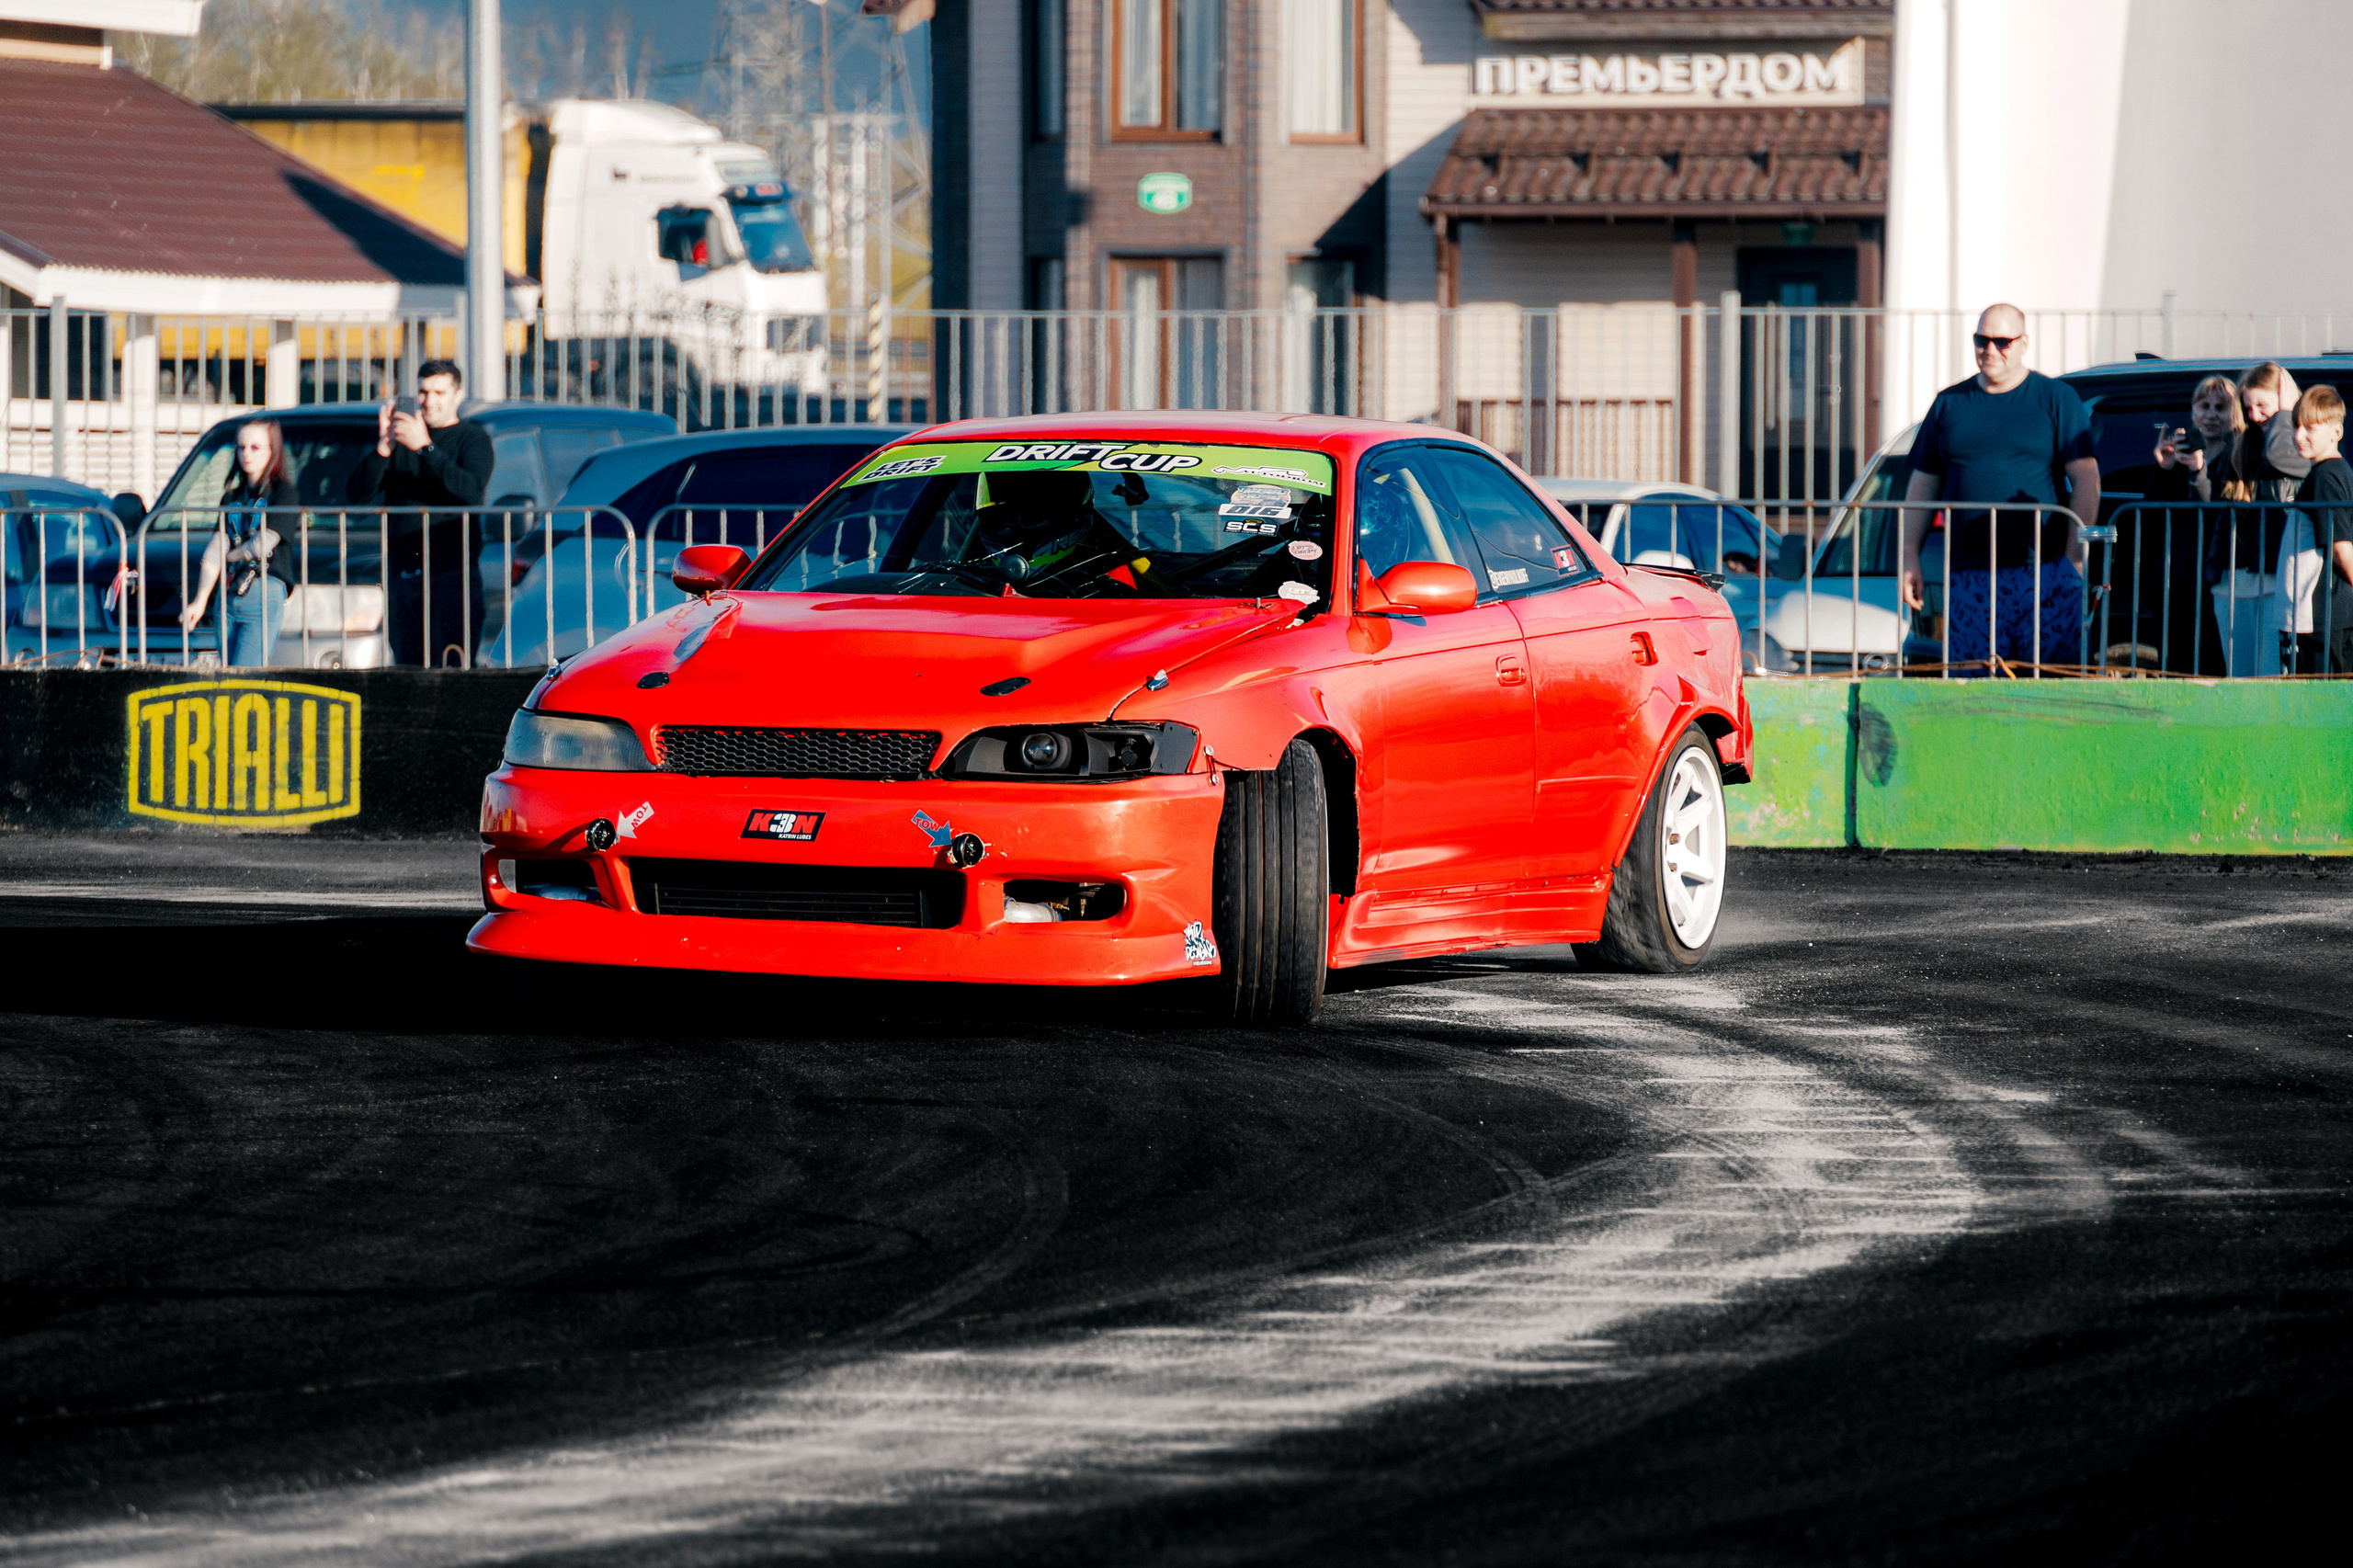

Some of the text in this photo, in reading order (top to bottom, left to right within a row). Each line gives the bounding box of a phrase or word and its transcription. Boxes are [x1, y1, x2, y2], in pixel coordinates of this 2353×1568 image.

[1474, 52, 1849, 99] ПРЕМЬЕРДОМ
[877, 456, 943, 472] LET'S
[985, 444, 1124, 461] DRIFT
[1099, 453, 1200, 472] CUP
[861, 463, 939, 481] DRIFT
[1225, 521, 1277, 534] SCS
[141, 692, 345, 812] TRIALLI
[631, 804, 649, 829] TOW
[747, 812, 820, 835] K3N
[915, 817, 938, 832] TOW
